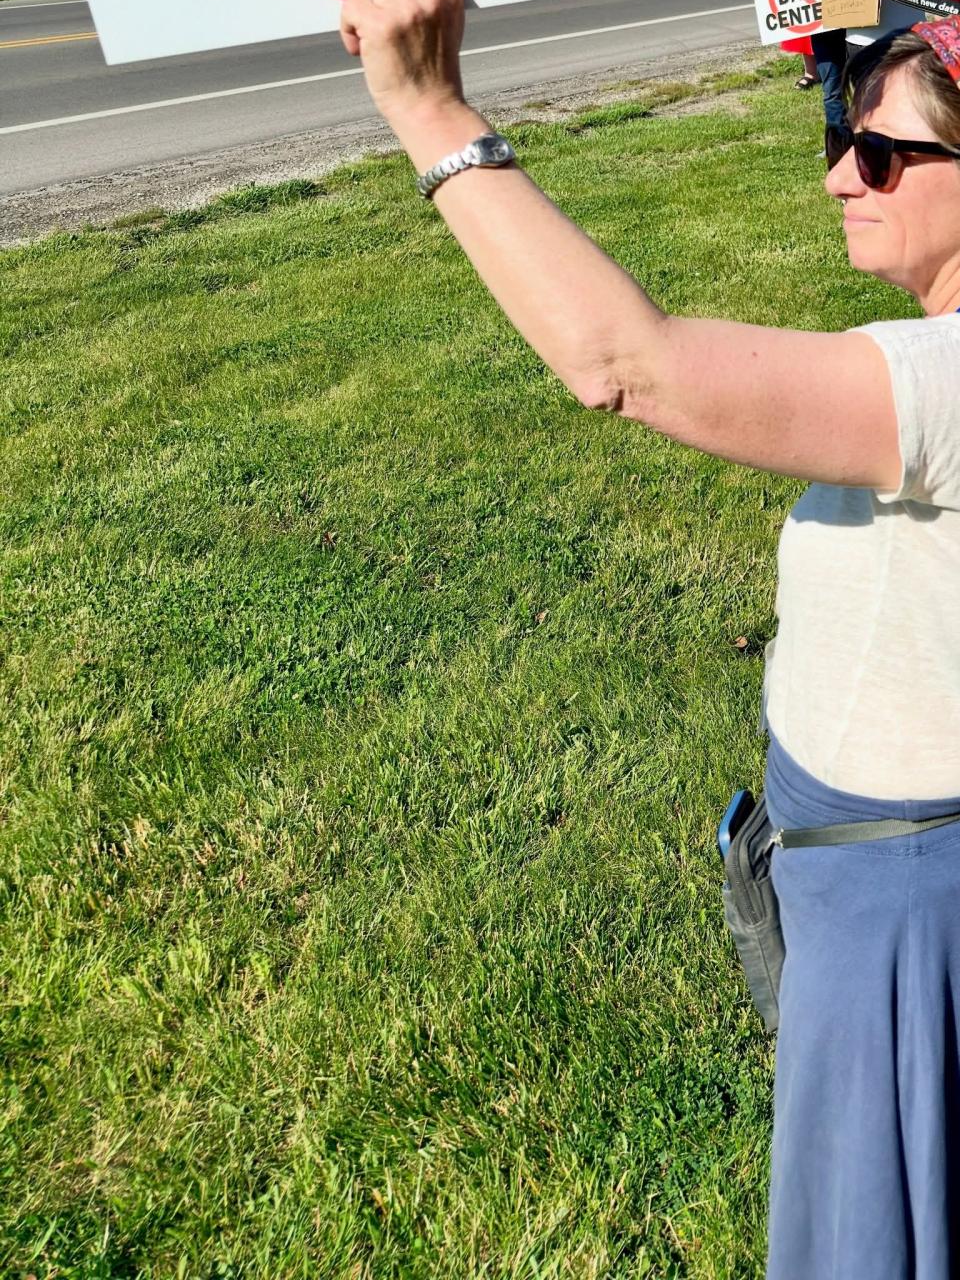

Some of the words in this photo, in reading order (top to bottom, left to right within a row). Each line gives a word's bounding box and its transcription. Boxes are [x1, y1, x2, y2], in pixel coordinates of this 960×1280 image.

[765, 2, 822, 31] CENTE
[920, 0, 938, 9] new
[938, 2, 959, 15] data
